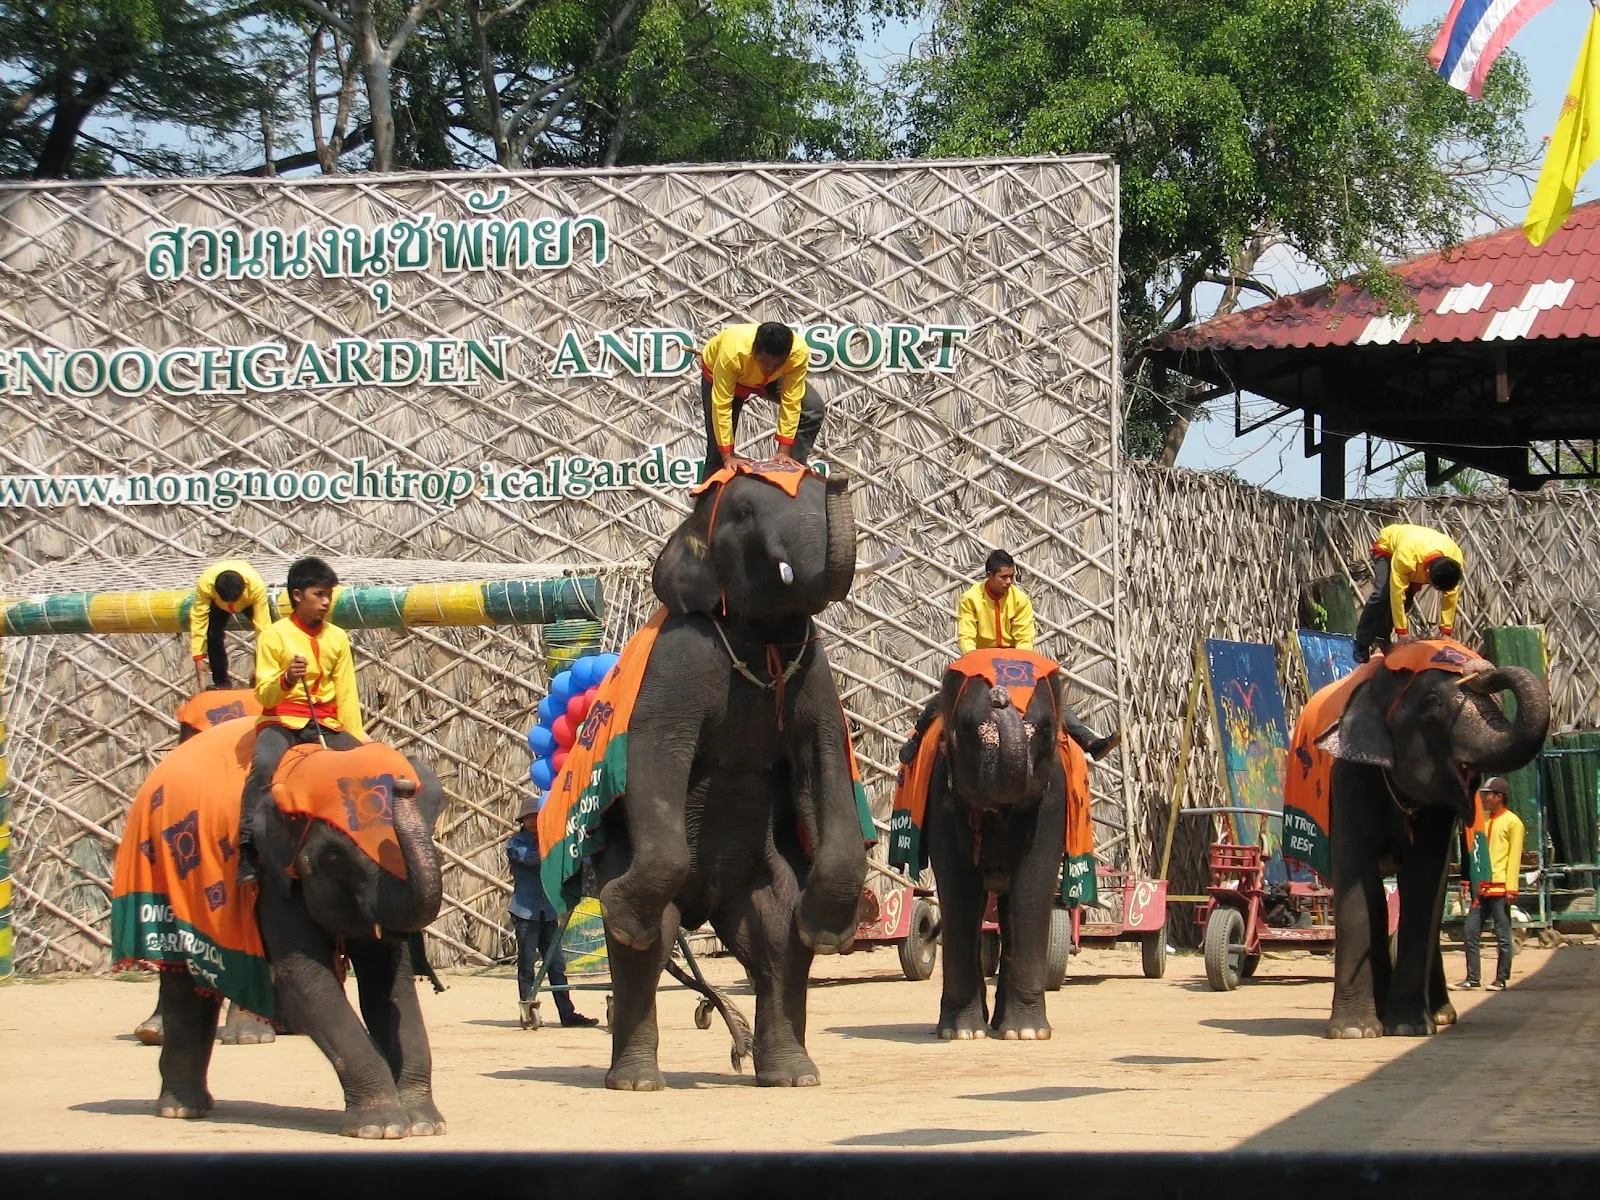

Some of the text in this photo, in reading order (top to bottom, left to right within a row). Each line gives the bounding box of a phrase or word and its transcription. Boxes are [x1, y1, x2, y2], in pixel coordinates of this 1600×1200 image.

[146, 187, 609, 312] สวนนงนุชพัทยา
[0, 323, 968, 396] NOOCHGARDEN AND SORT
